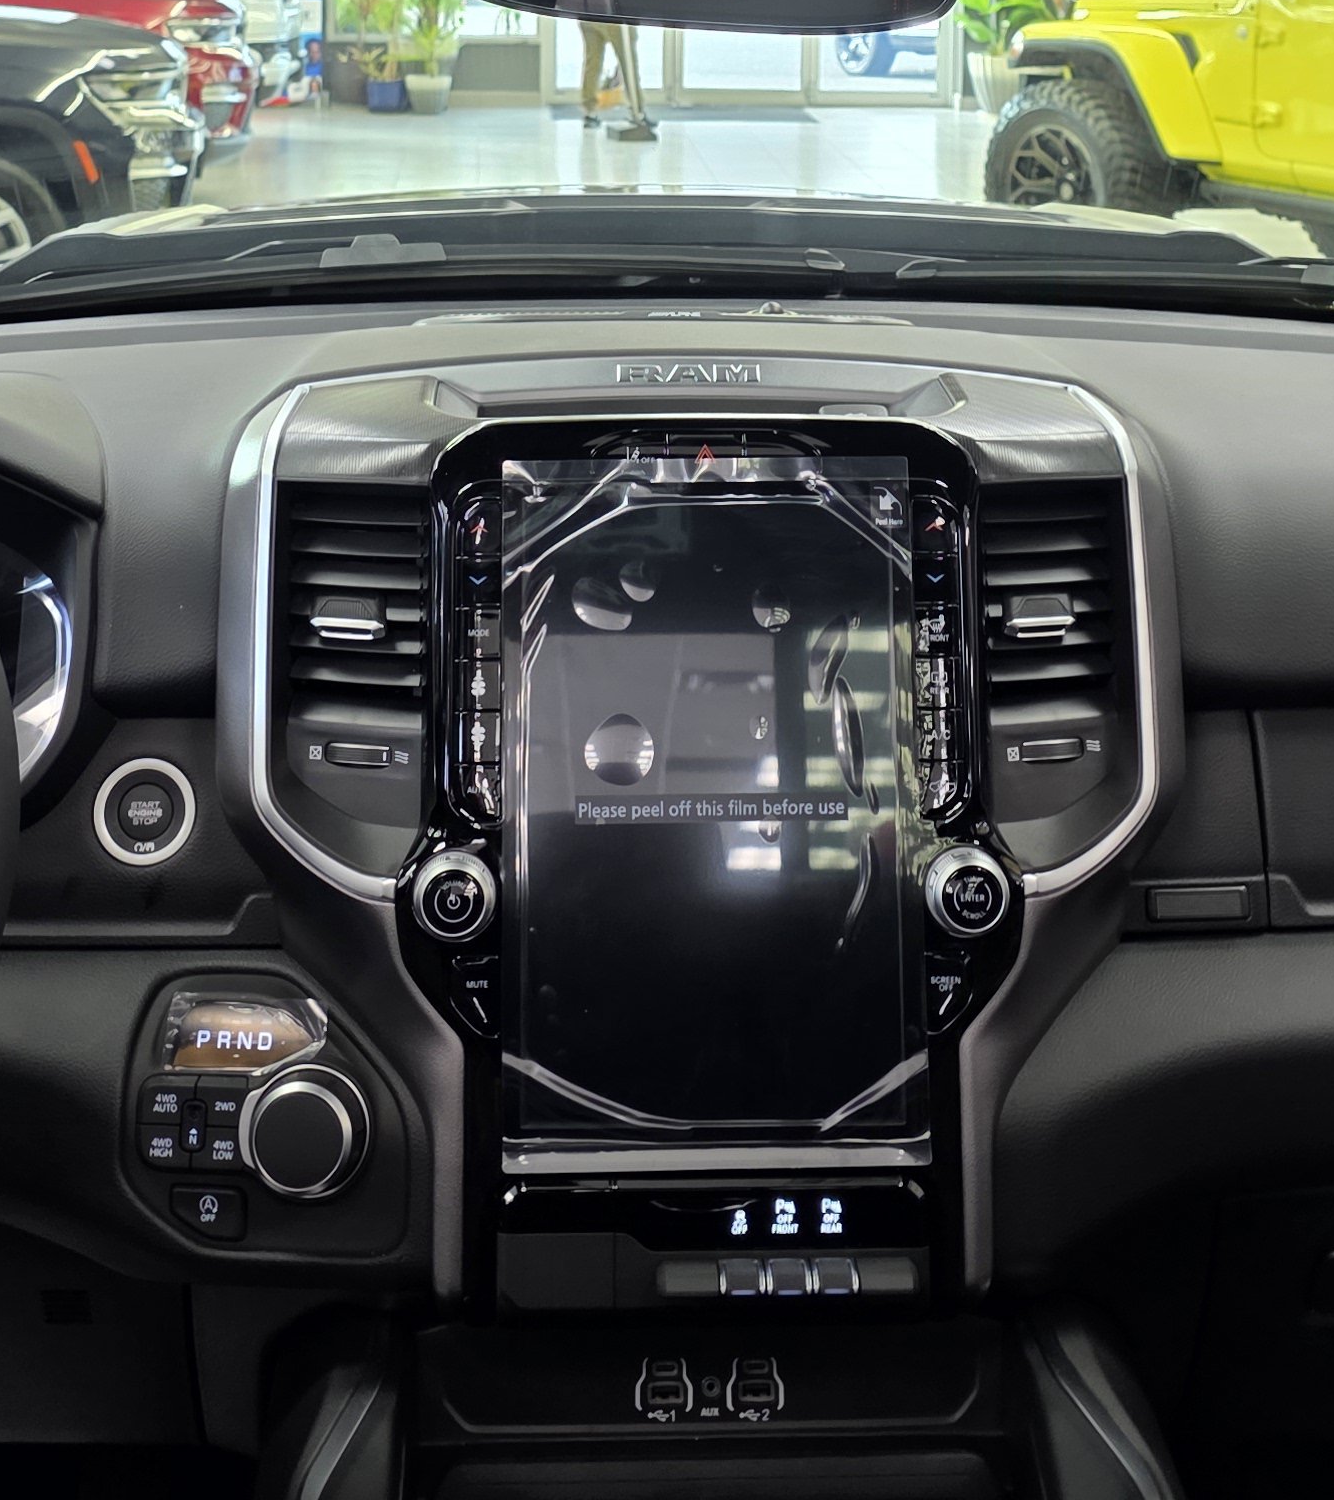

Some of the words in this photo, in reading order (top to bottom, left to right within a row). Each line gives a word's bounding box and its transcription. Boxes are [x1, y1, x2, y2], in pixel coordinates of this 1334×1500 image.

[616, 364, 761, 383] RAM
[468, 628, 490, 637] MODE
[929, 633, 950, 642] RONT
[931, 730, 951, 740] A/C
[130, 801, 161, 809] START
[578, 802, 627, 819] Please
[631, 801, 664, 820] peel
[669, 800, 692, 817] off
[695, 800, 724, 817] this
[728, 799, 757, 816] film
[762, 798, 814, 816] before
[818, 801, 845, 815] use
[128, 808, 163, 818] ENGINE
[132, 817, 158, 825] STOP
[465, 980, 489, 989] MUTE
[930, 975, 962, 985] SCREEN
[938, 984, 954, 992] OFF
[155, 1093, 177, 1103] 4WD
[153, 1103, 178, 1113] AUTO
[214, 1101, 236, 1111] 2WD
[151, 1138, 173, 1148] 4WD
[188, 1135, 197, 1145] N
[213, 1140, 234, 1150] 4WD
[149, 1148, 173, 1158] HIGH
[213, 1150, 234, 1160] LOW
[200, 1214, 216, 1223] OFF
[776, 1213, 794, 1224] OFF
[822, 1213, 840, 1224] OFF
[730, 1223, 748, 1235] OFF
[771, 1223, 799, 1234] FRONT
[820, 1223, 843, 1234] REAR
[670, 1409, 676, 1422] 1
[700, 1407, 719, 1417] AUX
[761, 1408, 770, 1421] 2
